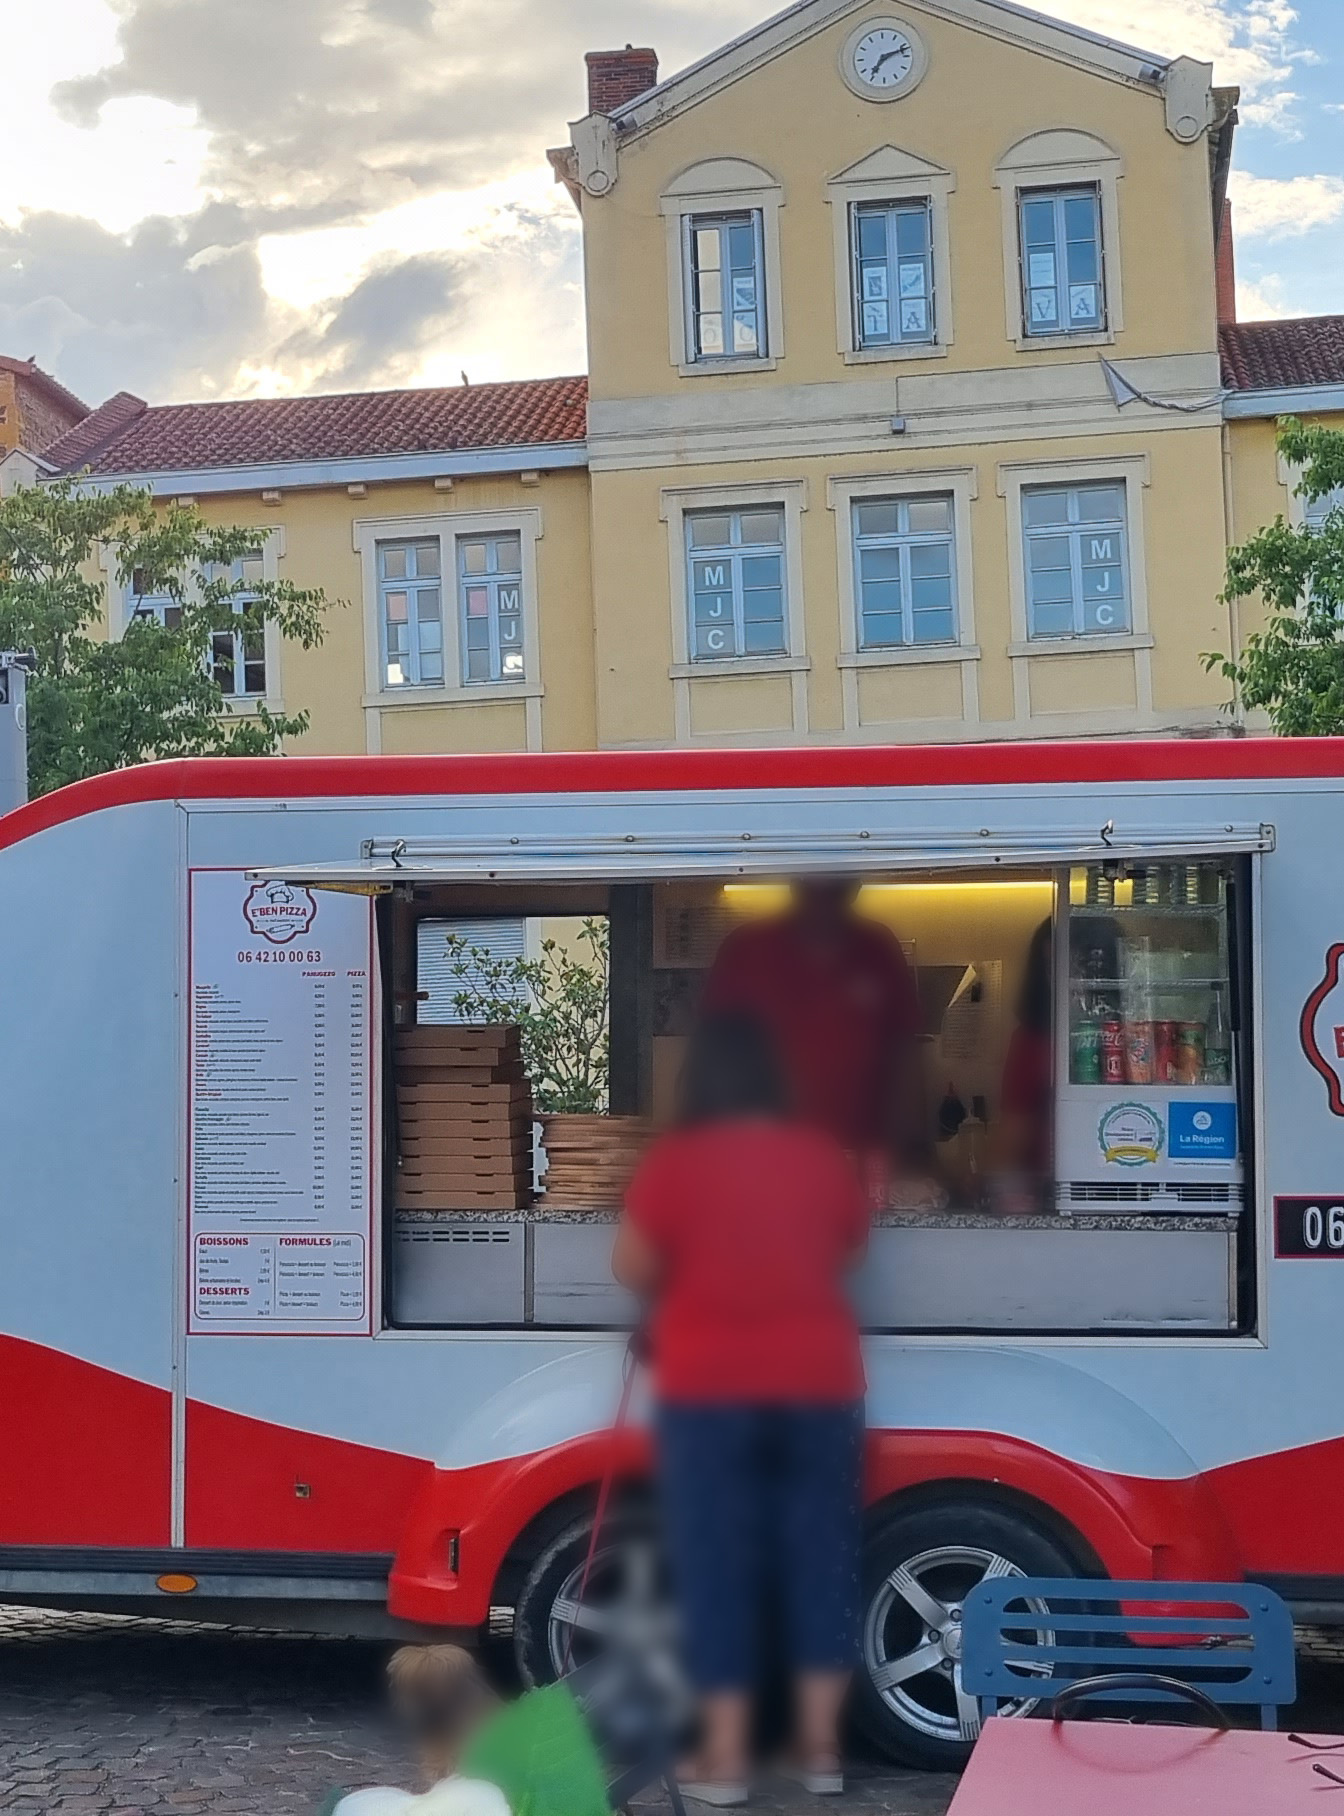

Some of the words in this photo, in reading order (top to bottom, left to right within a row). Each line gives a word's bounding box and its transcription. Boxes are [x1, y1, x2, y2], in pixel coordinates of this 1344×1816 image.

[279, 906, 307, 917] PIZZA
[237, 951, 252, 963] 06
[255, 951, 270, 963] 42
[272, 951, 286, 963] 10
[288, 951, 303, 963] 00
[306, 951, 321, 963] 63
[1180, 1134, 1190, 1143] La
[1193, 1134, 1224, 1144] Région
[199, 1237, 249, 1246] BOISSONS
[279, 1237, 332, 1246] FORMULES
[199, 1287, 250, 1295] DESSERTS
